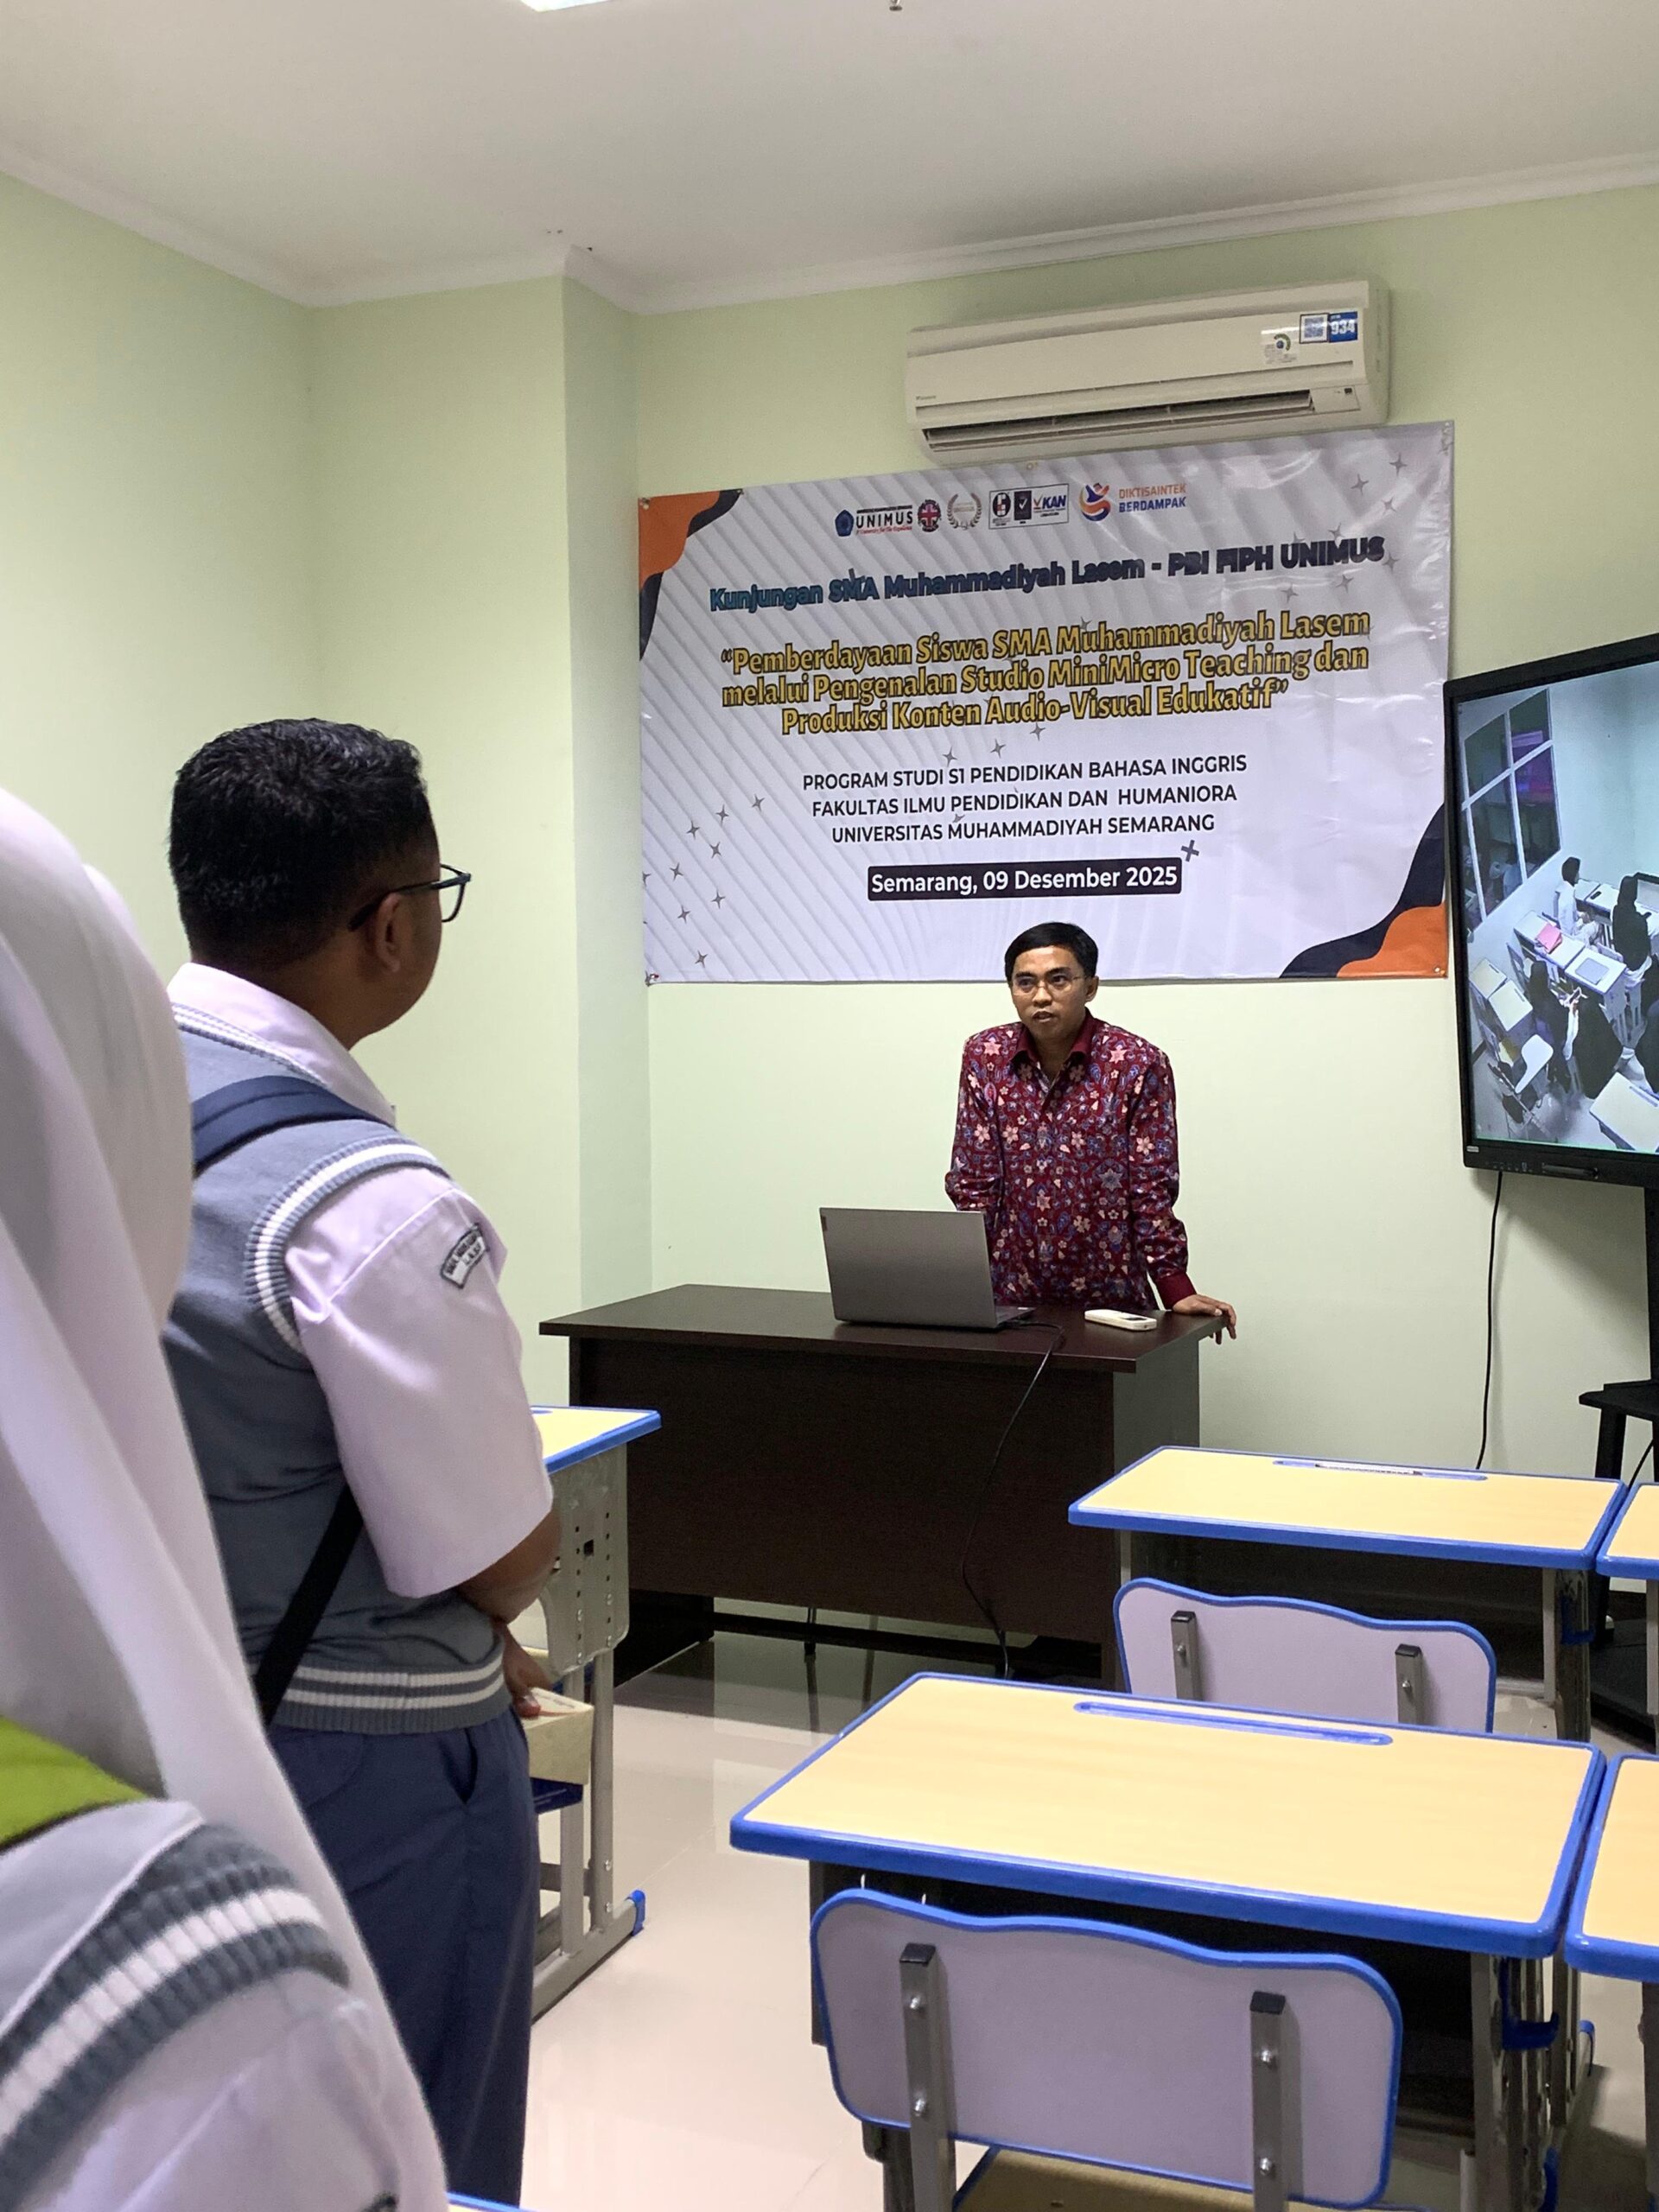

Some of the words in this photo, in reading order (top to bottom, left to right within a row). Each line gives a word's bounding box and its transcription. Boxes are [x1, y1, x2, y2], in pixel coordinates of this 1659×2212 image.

[1042, 494, 1067, 509] KAN
[1119, 483, 1186, 499] DIKTISAINTEK
[1119, 496, 1186, 512] BERDAMPAK
[856, 511, 913, 529] UNIMUS
[710, 583, 823, 613] Kunjungan
[829, 576, 880, 603] SMA
[885, 562, 1065, 600] Muhammadiyah
[1071, 558, 1146, 584] Lasem
[1167, 550, 1210, 576] PBI
[1281, 536, 1385, 569] UNIMUS
[916, 632, 988, 664] Siswa
[992, 627, 1052, 658] SMA
[1057, 610, 1275, 654] Muhammadiyah
[1280, 610, 1370, 640] Lasem
[721, 673, 809, 707] melalui
[813, 666, 957, 705] Pengenalan
[961, 659, 1045, 693] Studio
[1048, 651, 1181, 689] MiniMicro
[1184, 643, 1313, 681] Teaching
[1313, 639, 1369, 672] dan
[782, 701, 888, 735] Produksi
[893, 702, 982, 730] Konten
[985, 685, 1152, 726] Audio-Visual
[803, 772, 888, 791] PROGRAM
[893, 769, 944, 786] STUDI
[948, 768, 965, 785] S1
[970, 762, 1083, 784] PENDIDIKAN
[1089, 759, 1166, 779] BAHASA
[1172, 754, 1248, 775] INGGRIS
[812, 798, 899, 817] FAKULTAS
[903, 796, 945, 814] ILMU
[950, 791, 1063, 811] PENDIDIKAN
[1068, 790, 1109, 807] DAN
[1118, 784, 1238, 805] HUMANIORA
[832, 823, 944, 843] UNIVERSITAS
[949, 818, 1103, 840] MUHAMMADIYAH
[1108, 814, 1215, 834] SEMARANG
[871, 874, 978, 895] Semarang,
[982, 871, 1008, 890] 09
[1014, 867, 1121, 890] Desember
[1126, 866, 1178, 887] 2025
